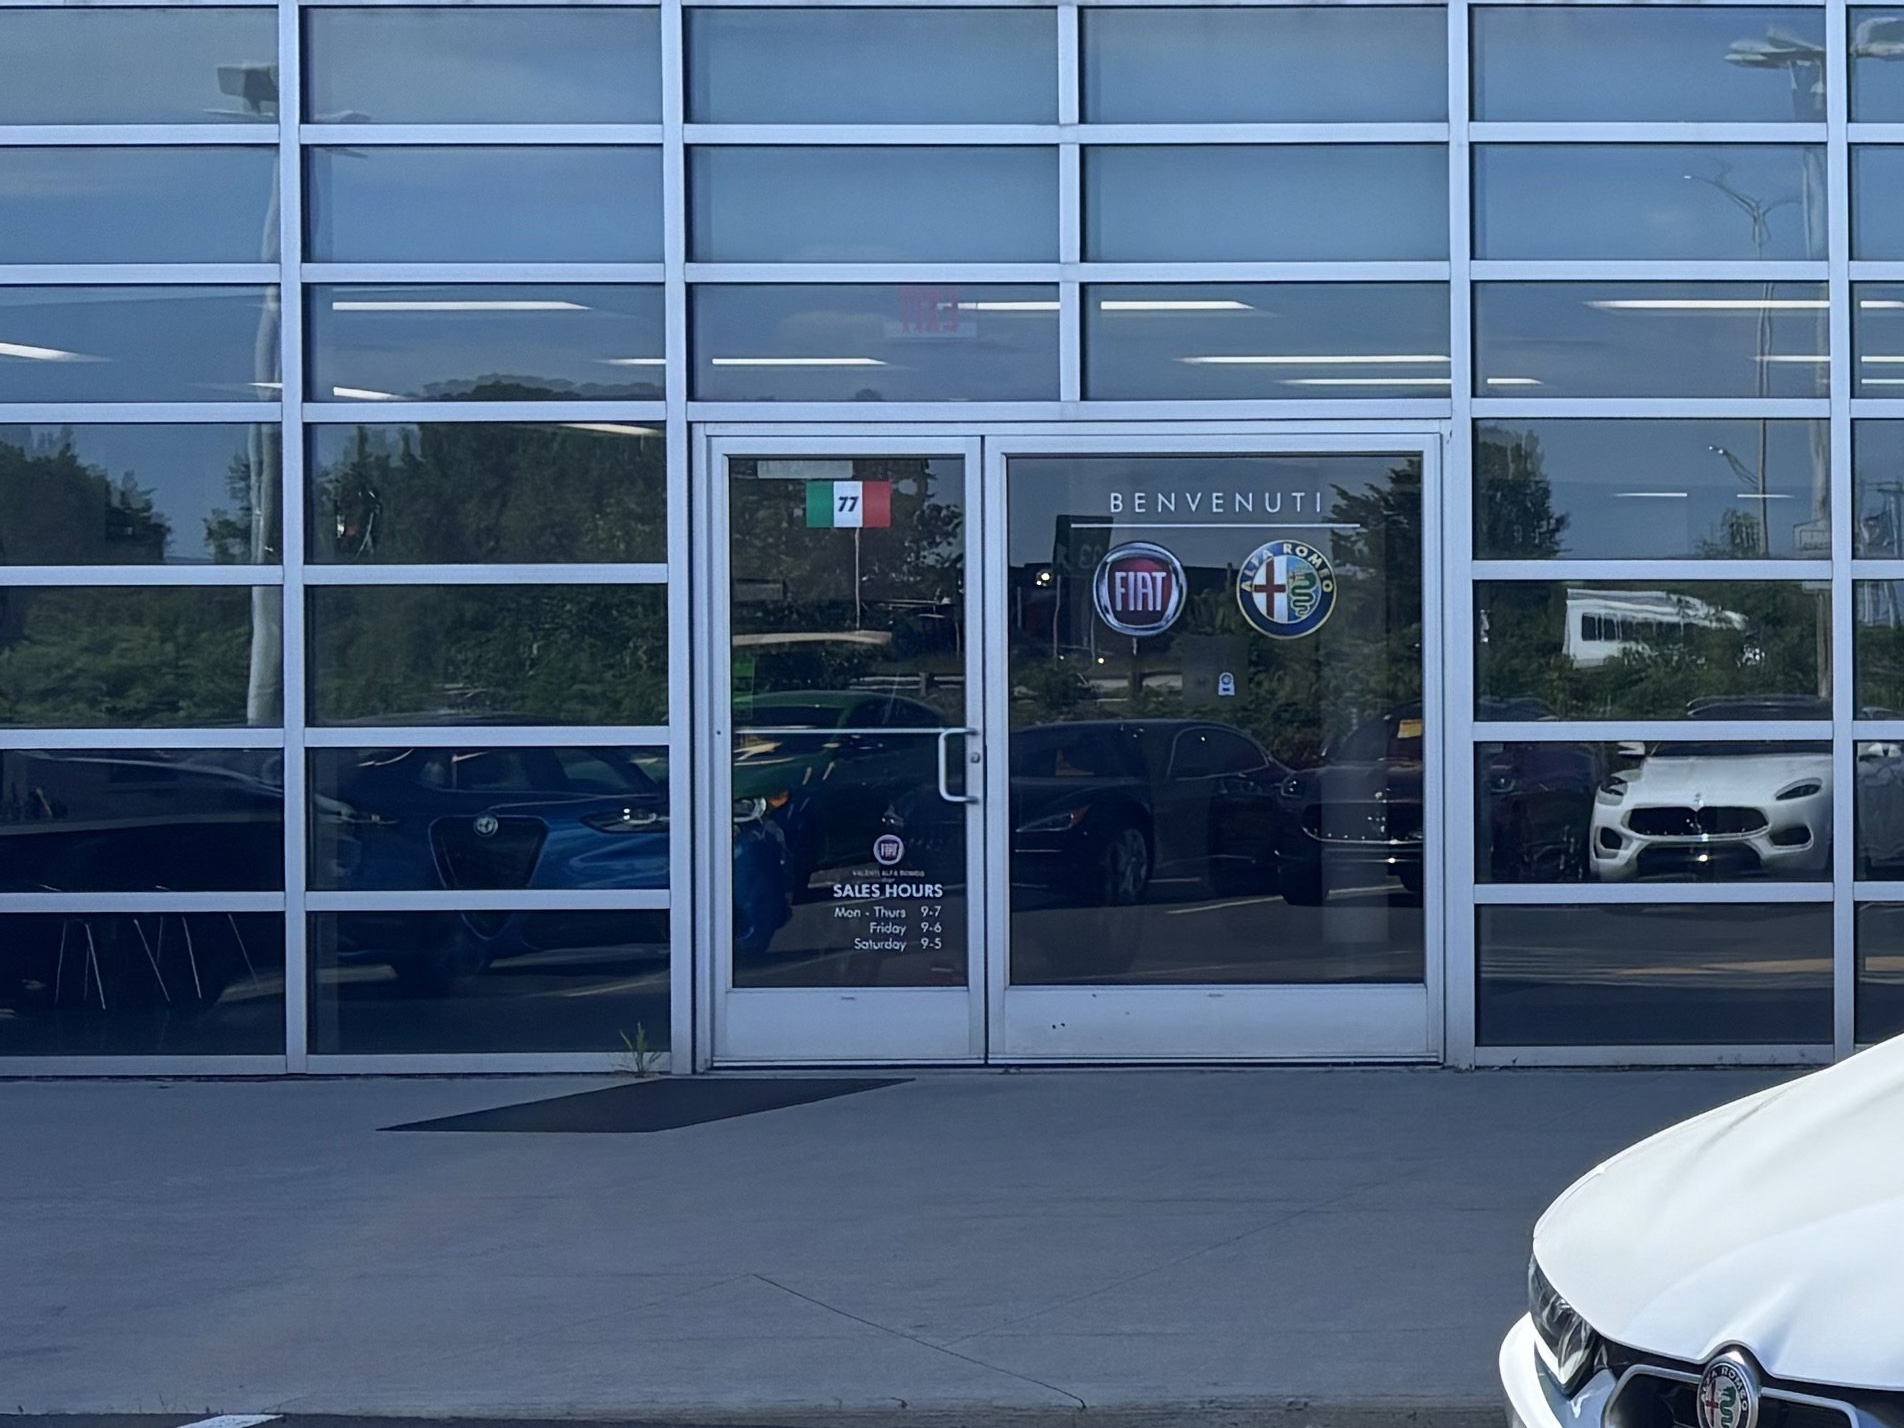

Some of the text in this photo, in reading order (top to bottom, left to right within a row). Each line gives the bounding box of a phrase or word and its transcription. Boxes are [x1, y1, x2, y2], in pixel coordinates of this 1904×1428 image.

[838, 496, 860, 513] 77
[1109, 492, 1322, 513] BENVENUTI
[1283, 543, 1333, 594] ROMEO
[1114, 571, 1167, 612] FIAT
[833, 884, 944, 898] SALES HOURS
[834, 906, 862, 918] Mon
[873, 906, 907, 918] Thurs
[920, 906, 942, 918] 9-7
[869, 922, 942, 936] Friday 9-6
[854, 938, 942, 952] Saturday 9-5
